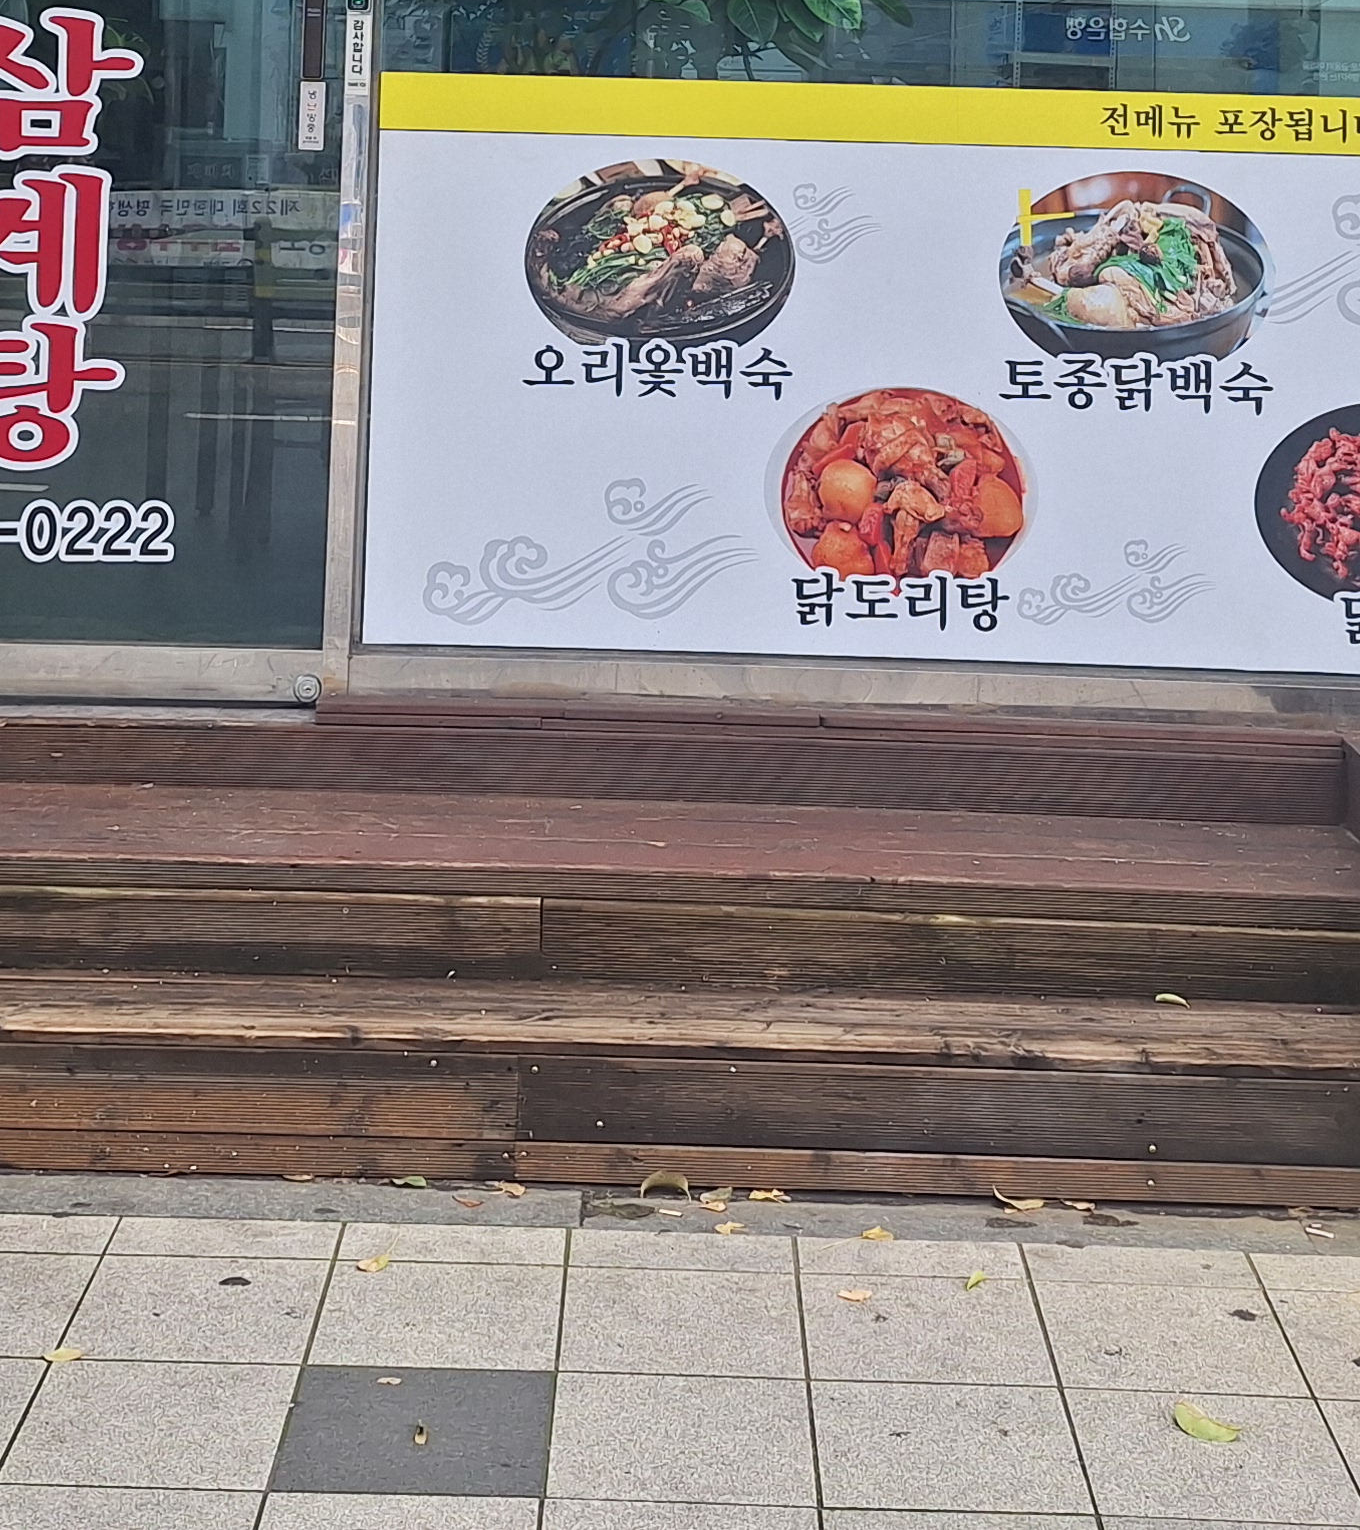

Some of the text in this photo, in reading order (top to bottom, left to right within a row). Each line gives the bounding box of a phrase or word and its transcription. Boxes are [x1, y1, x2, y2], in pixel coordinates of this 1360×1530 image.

[351, 19, 365, 76] 감사합니다
[1098, 102, 1202, 140] 전메뉴
[522, 342, 793, 400] 오리옻백숙
[999, 354, 1275, 415] 토종닭백숙
[791, 574, 1010, 633] 닭도리탕
